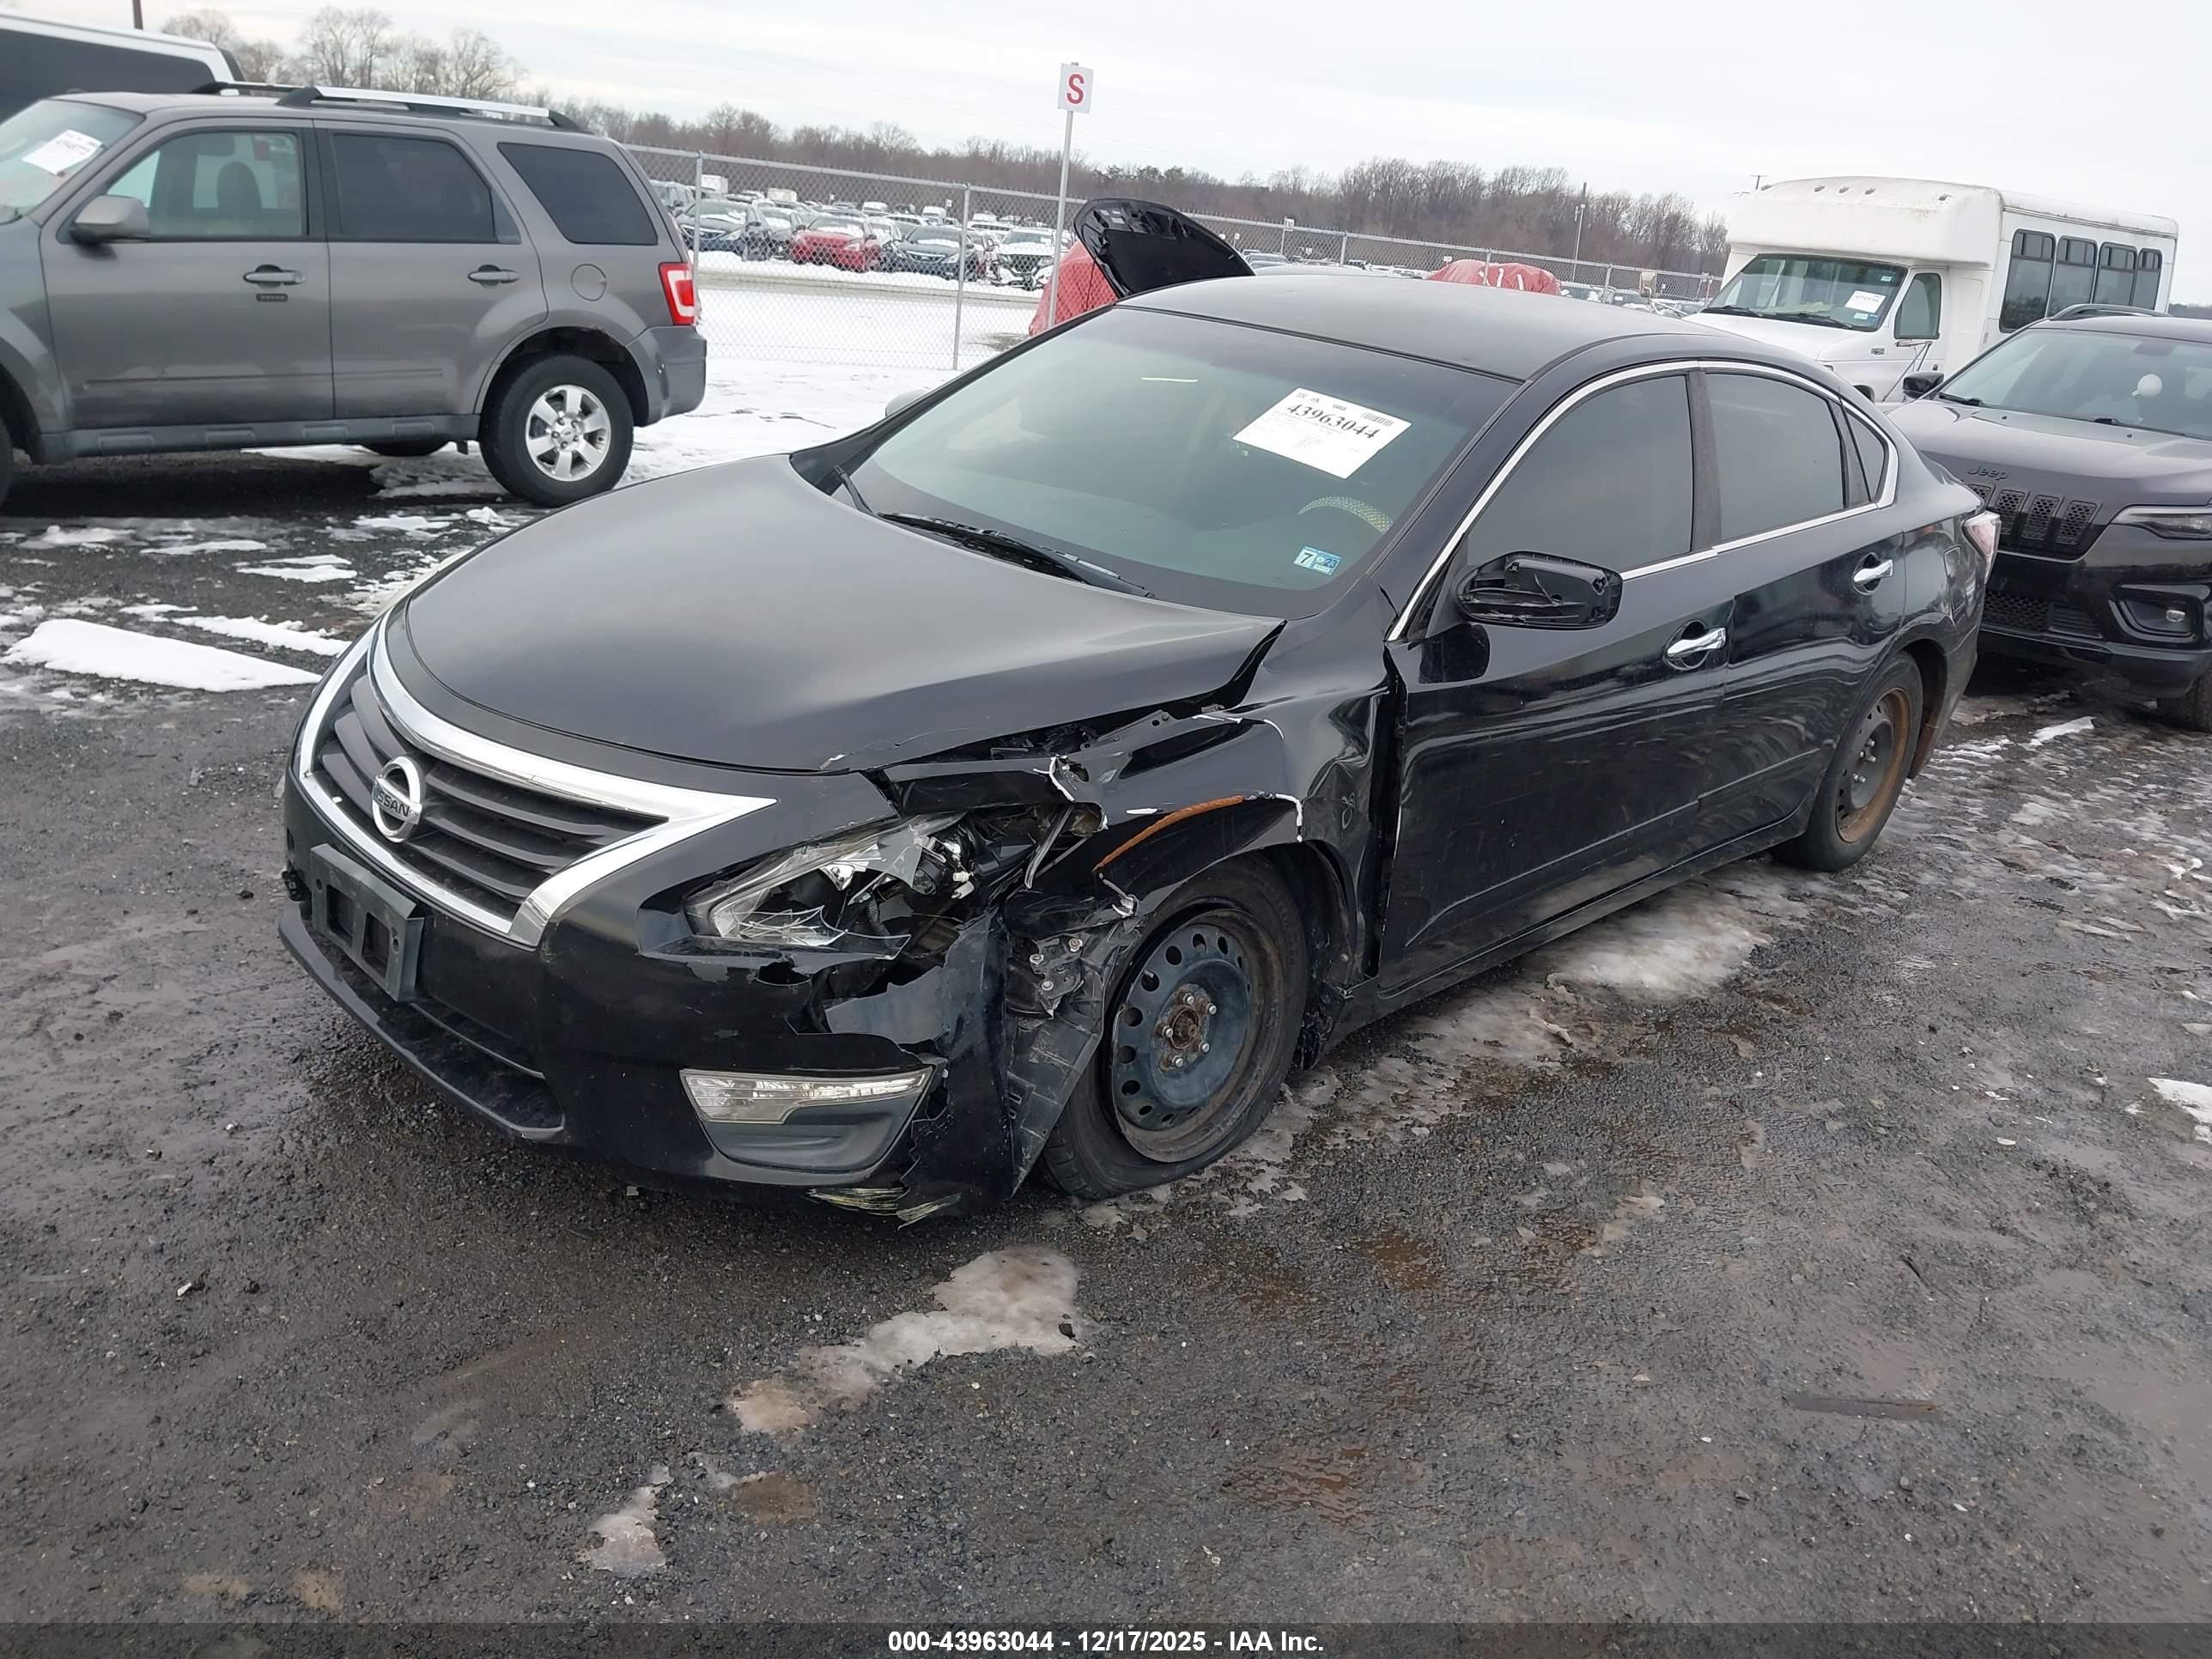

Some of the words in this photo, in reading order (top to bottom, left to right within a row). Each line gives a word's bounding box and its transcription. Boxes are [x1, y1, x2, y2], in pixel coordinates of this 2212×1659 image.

[1066, 73, 1085, 105] S
[1286, 403, 1382, 440] 43963044
[1966, 465, 2009, 481] Jeep
[1300, 552, 1314, 564] 7
[1323, 557, 1338, 568] 23
